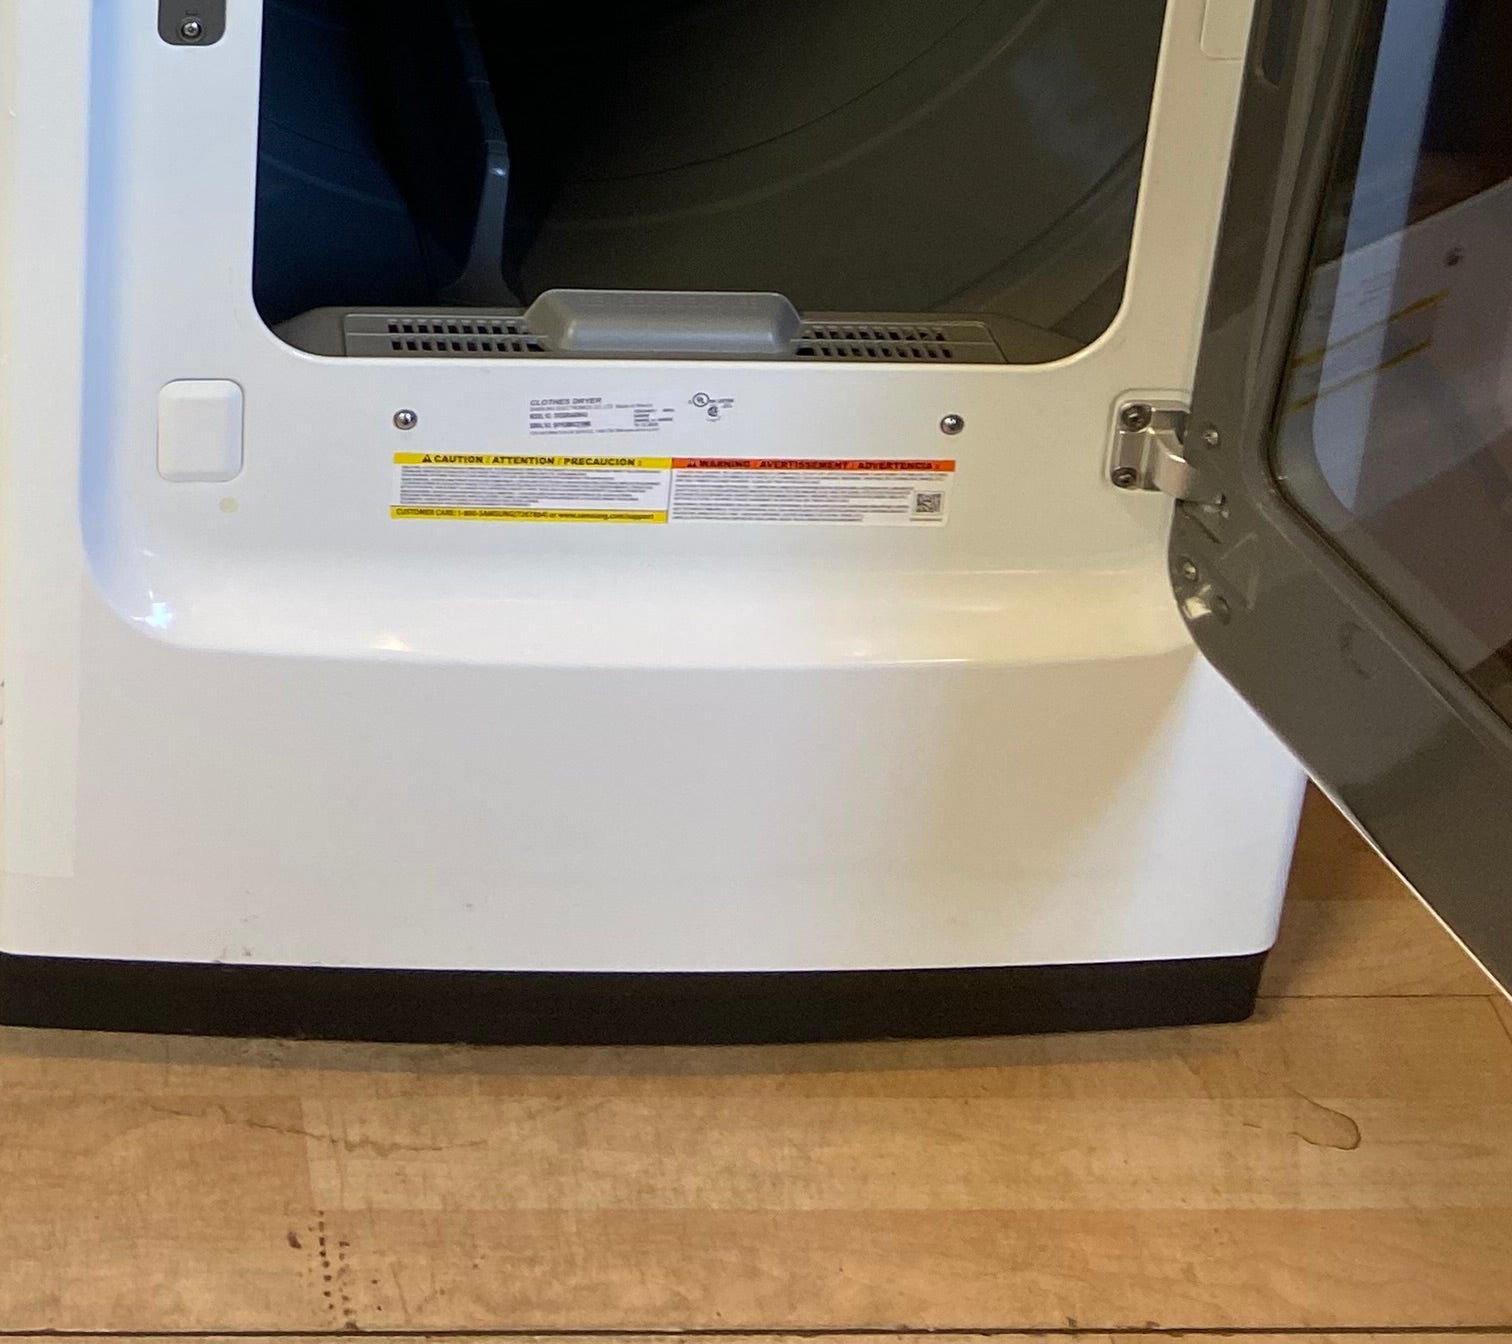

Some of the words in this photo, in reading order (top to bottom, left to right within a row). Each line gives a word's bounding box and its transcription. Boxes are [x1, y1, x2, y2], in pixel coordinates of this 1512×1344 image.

[529, 398, 570, 406] CLOTHES
[572, 397, 602, 405] DRYER
[434, 455, 483, 464] CAUTION
[492, 456, 554, 465] ATTENTION
[699, 460, 750, 469] WARNING
[759, 461, 848, 470] AVERTISSEMENT
[858, 461, 934, 470] ADVERTENCIA
